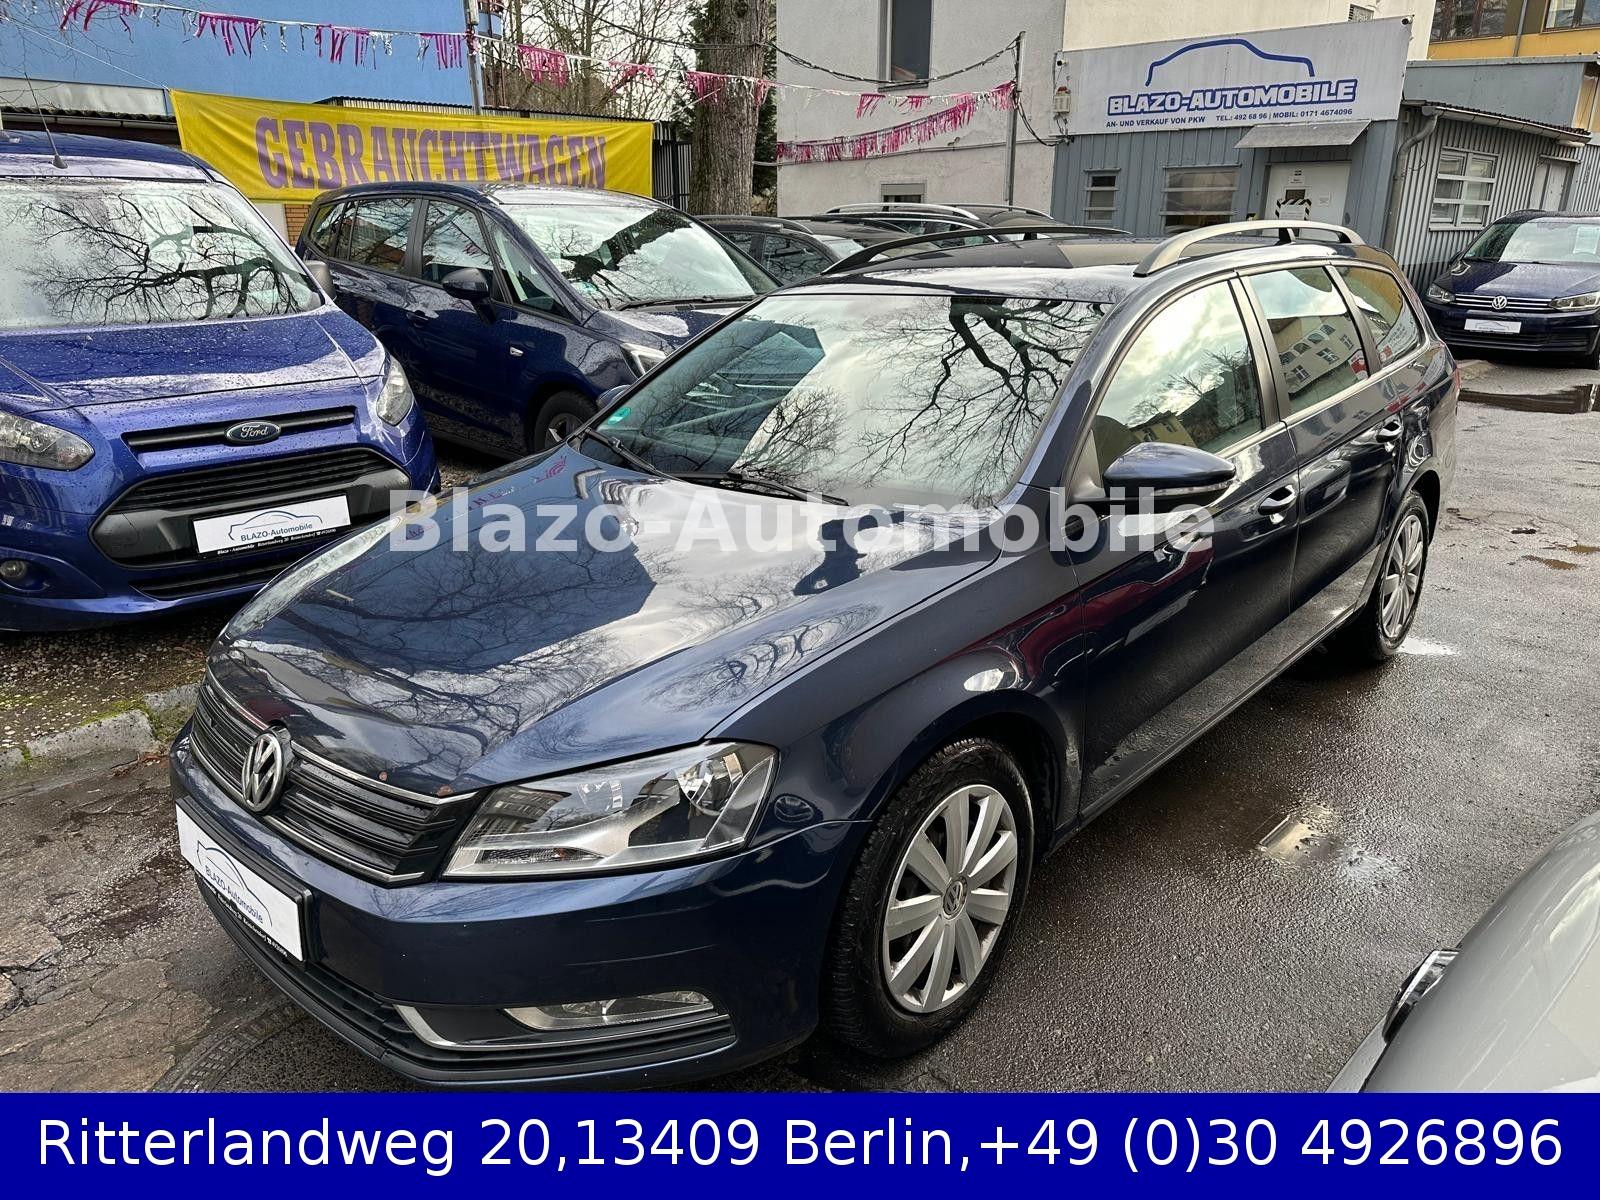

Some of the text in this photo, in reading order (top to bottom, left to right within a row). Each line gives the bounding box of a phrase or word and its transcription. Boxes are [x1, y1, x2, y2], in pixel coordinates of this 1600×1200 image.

[1107, 79, 1358, 116] BLAZO-AUTOMOBILE
[1106, 120, 1118, 128] AN-
[1136, 118, 1169, 126] VERKAUF
[1272, 111, 1299, 119] MOBIL:
[1300, 110, 1318, 118] 0171
[1320, 108, 1353, 117] 4674096
[255, 116, 606, 190] GEBRAUCHTWAGEN
[240, 424, 269, 438] Ford
[240, 523, 313, 542] BLAZO-Automobile
[204, 864, 264, 925] BLAZO-Automobile
